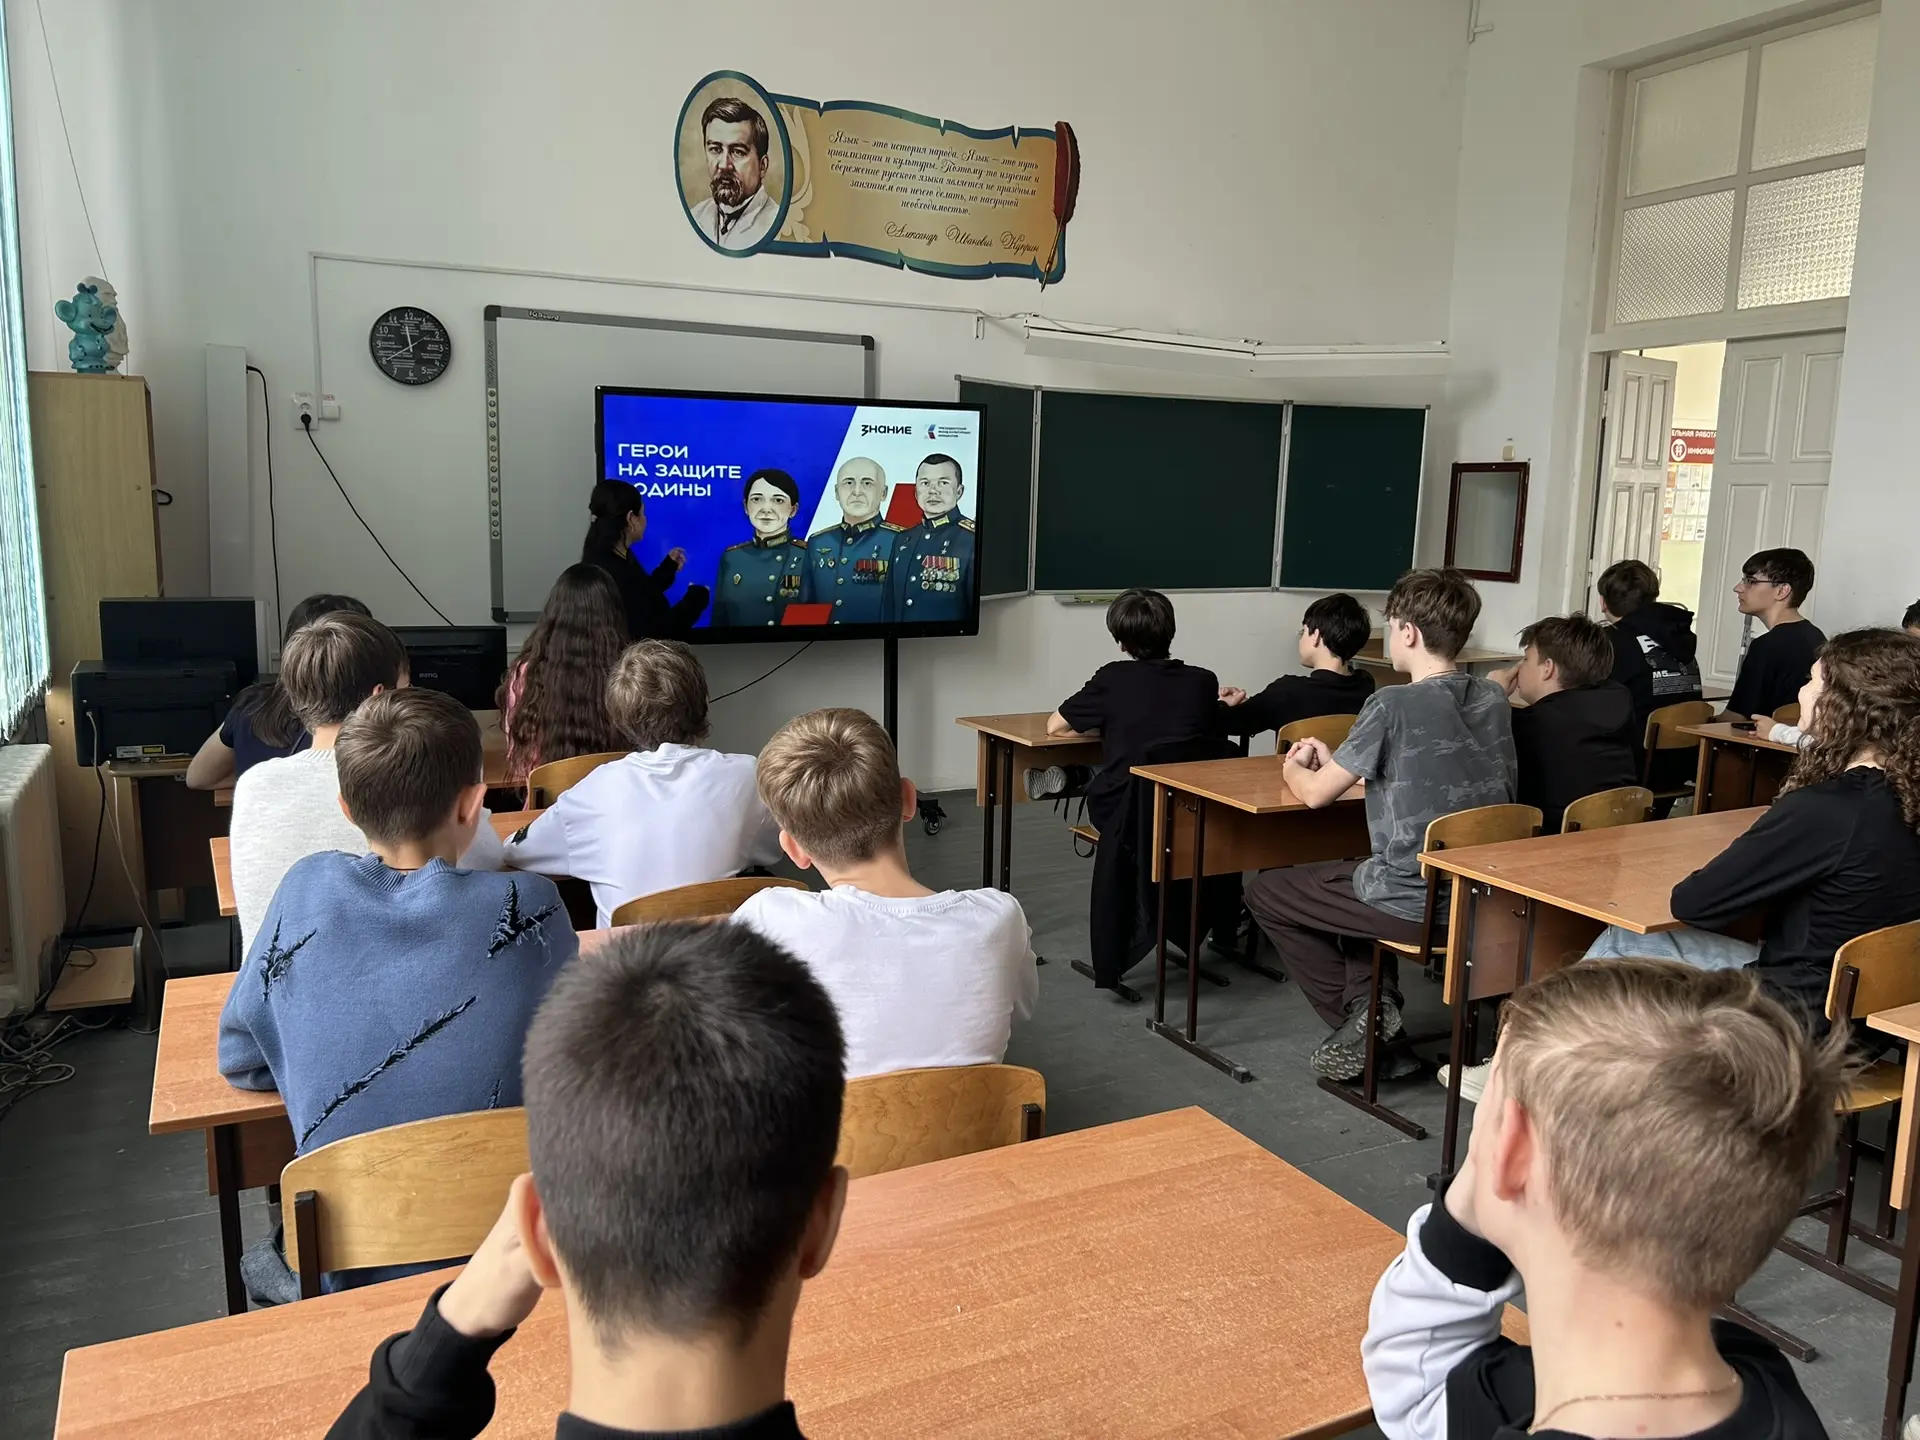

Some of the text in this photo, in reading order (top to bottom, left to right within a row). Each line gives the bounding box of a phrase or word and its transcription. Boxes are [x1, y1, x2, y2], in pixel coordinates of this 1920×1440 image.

[829, 130, 859, 145] Язык
[872, 139, 888, 149] это
[890, 142, 927, 157] история
[928, 146, 958, 160] народа.
[961, 149, 990, 162] Язык
[1001, 158, 1017, 167] это
[1018, 159, 1039, 172] путь
[827, 148, 883, 163] цивилизации
[892, 158, 938, 172] культуры.
[999, 171, 1032, 184] изучение
[830, 160, 880, 176] сбережение
[881, 169, 917, 182] русского
[918, 174, 944, 184] языка
[945, 178, 983, 190] является
[996, 182, 1037, 196] праздным
[849, 180, 894, 192] занятием
[910, 187, 934, 197] нечего
[968, 194, 978, 202] но
[980, 195, 1019, 210] насущной
[900, 199, 971, 215] необходимостью.
[884, 221, 1040, 256] Александр Иванович Куприн
[1672, 429, 1694, 438] ЕЛЬНАЯ
[618, 443, 689, 459] ГЕРОИ
[618, 463, 742, 480] НА ЗАЩИТЕ
[634, 482, 711, 498] ОДИНЫ
